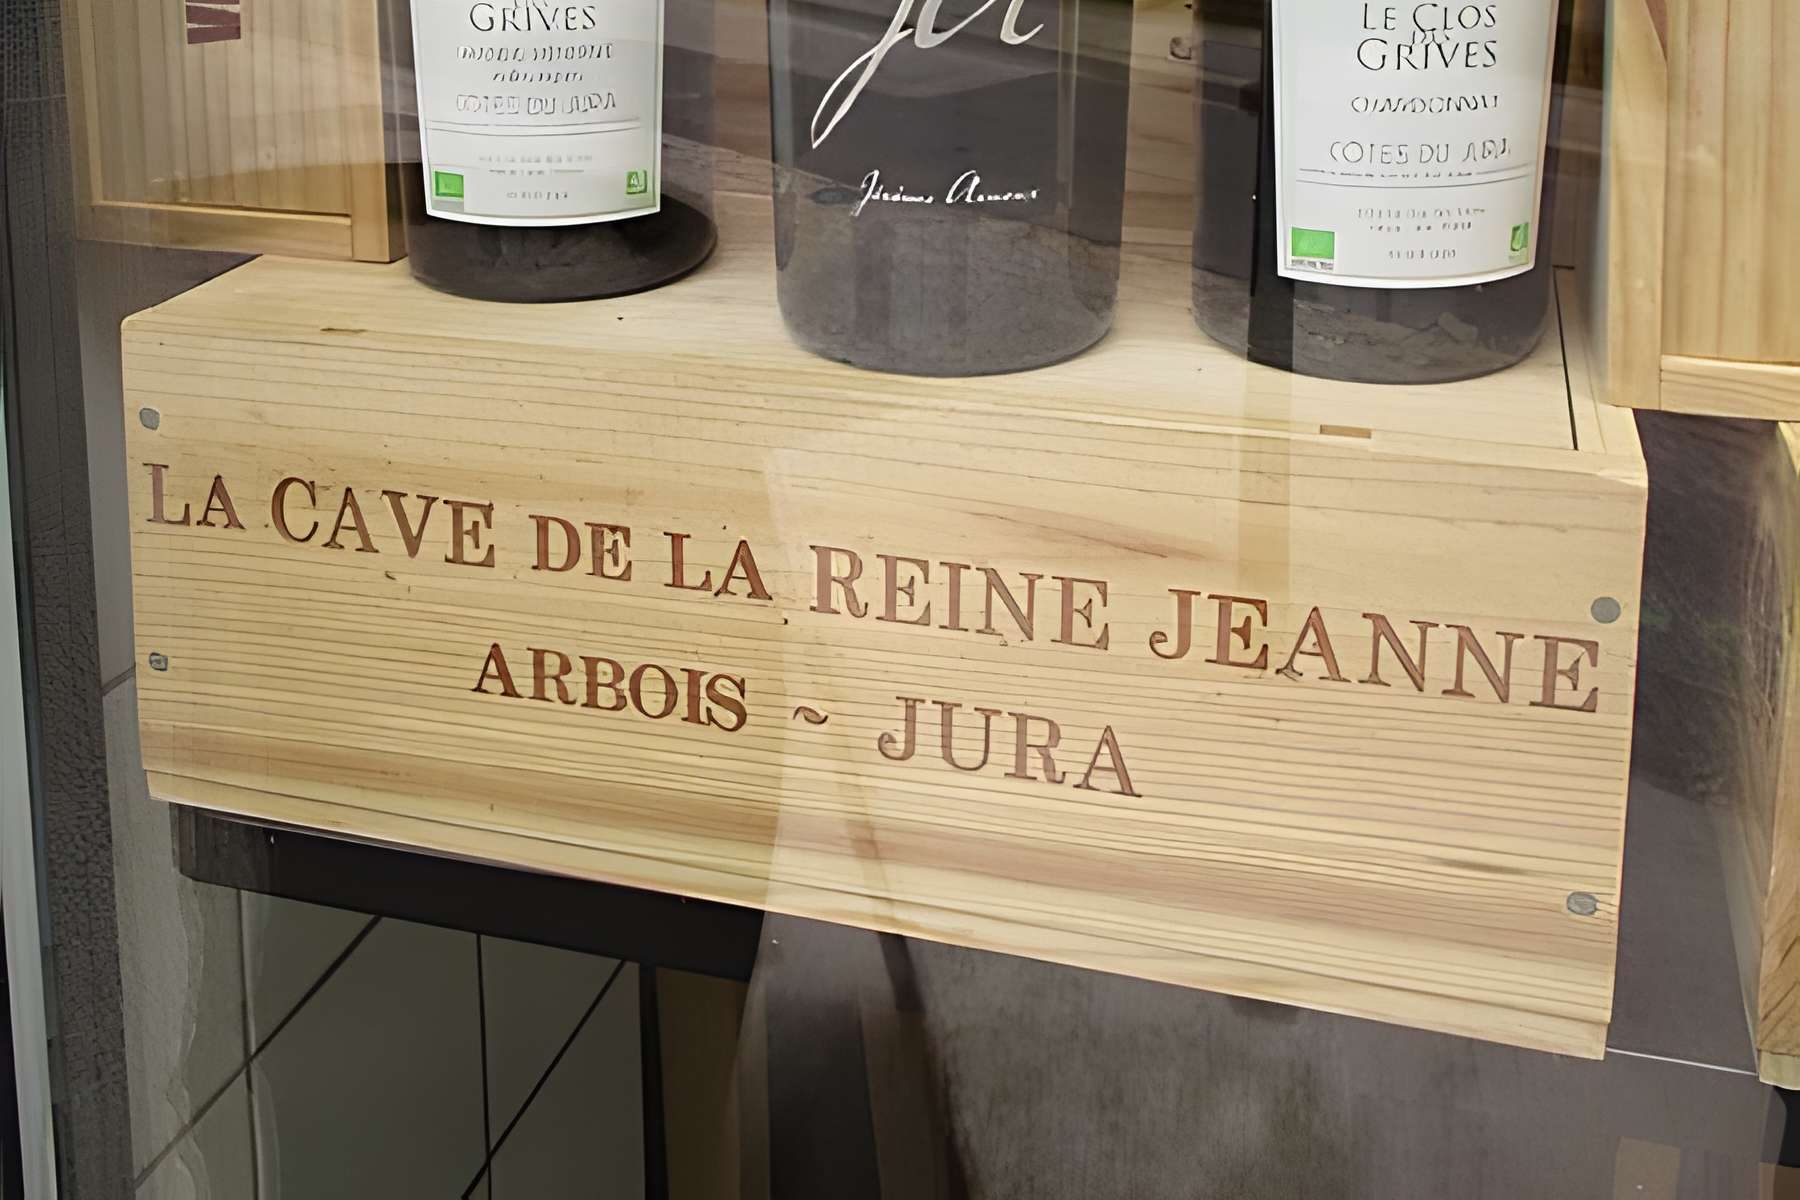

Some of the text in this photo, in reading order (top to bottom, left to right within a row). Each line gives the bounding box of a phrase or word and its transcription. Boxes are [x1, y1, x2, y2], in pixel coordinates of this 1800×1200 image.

[469, 2, 597, 32] GRIVES
[1363, 2, 1498, 32] LE CLOS
[1356, 37, 1498, 71] GRIVES
[142, 462, 1601, 714] LA CAVE DE LA REINE JEANNE
[471, 641, 748, 733] ARBOIS
[876, 695, 1144, 799] JURA
